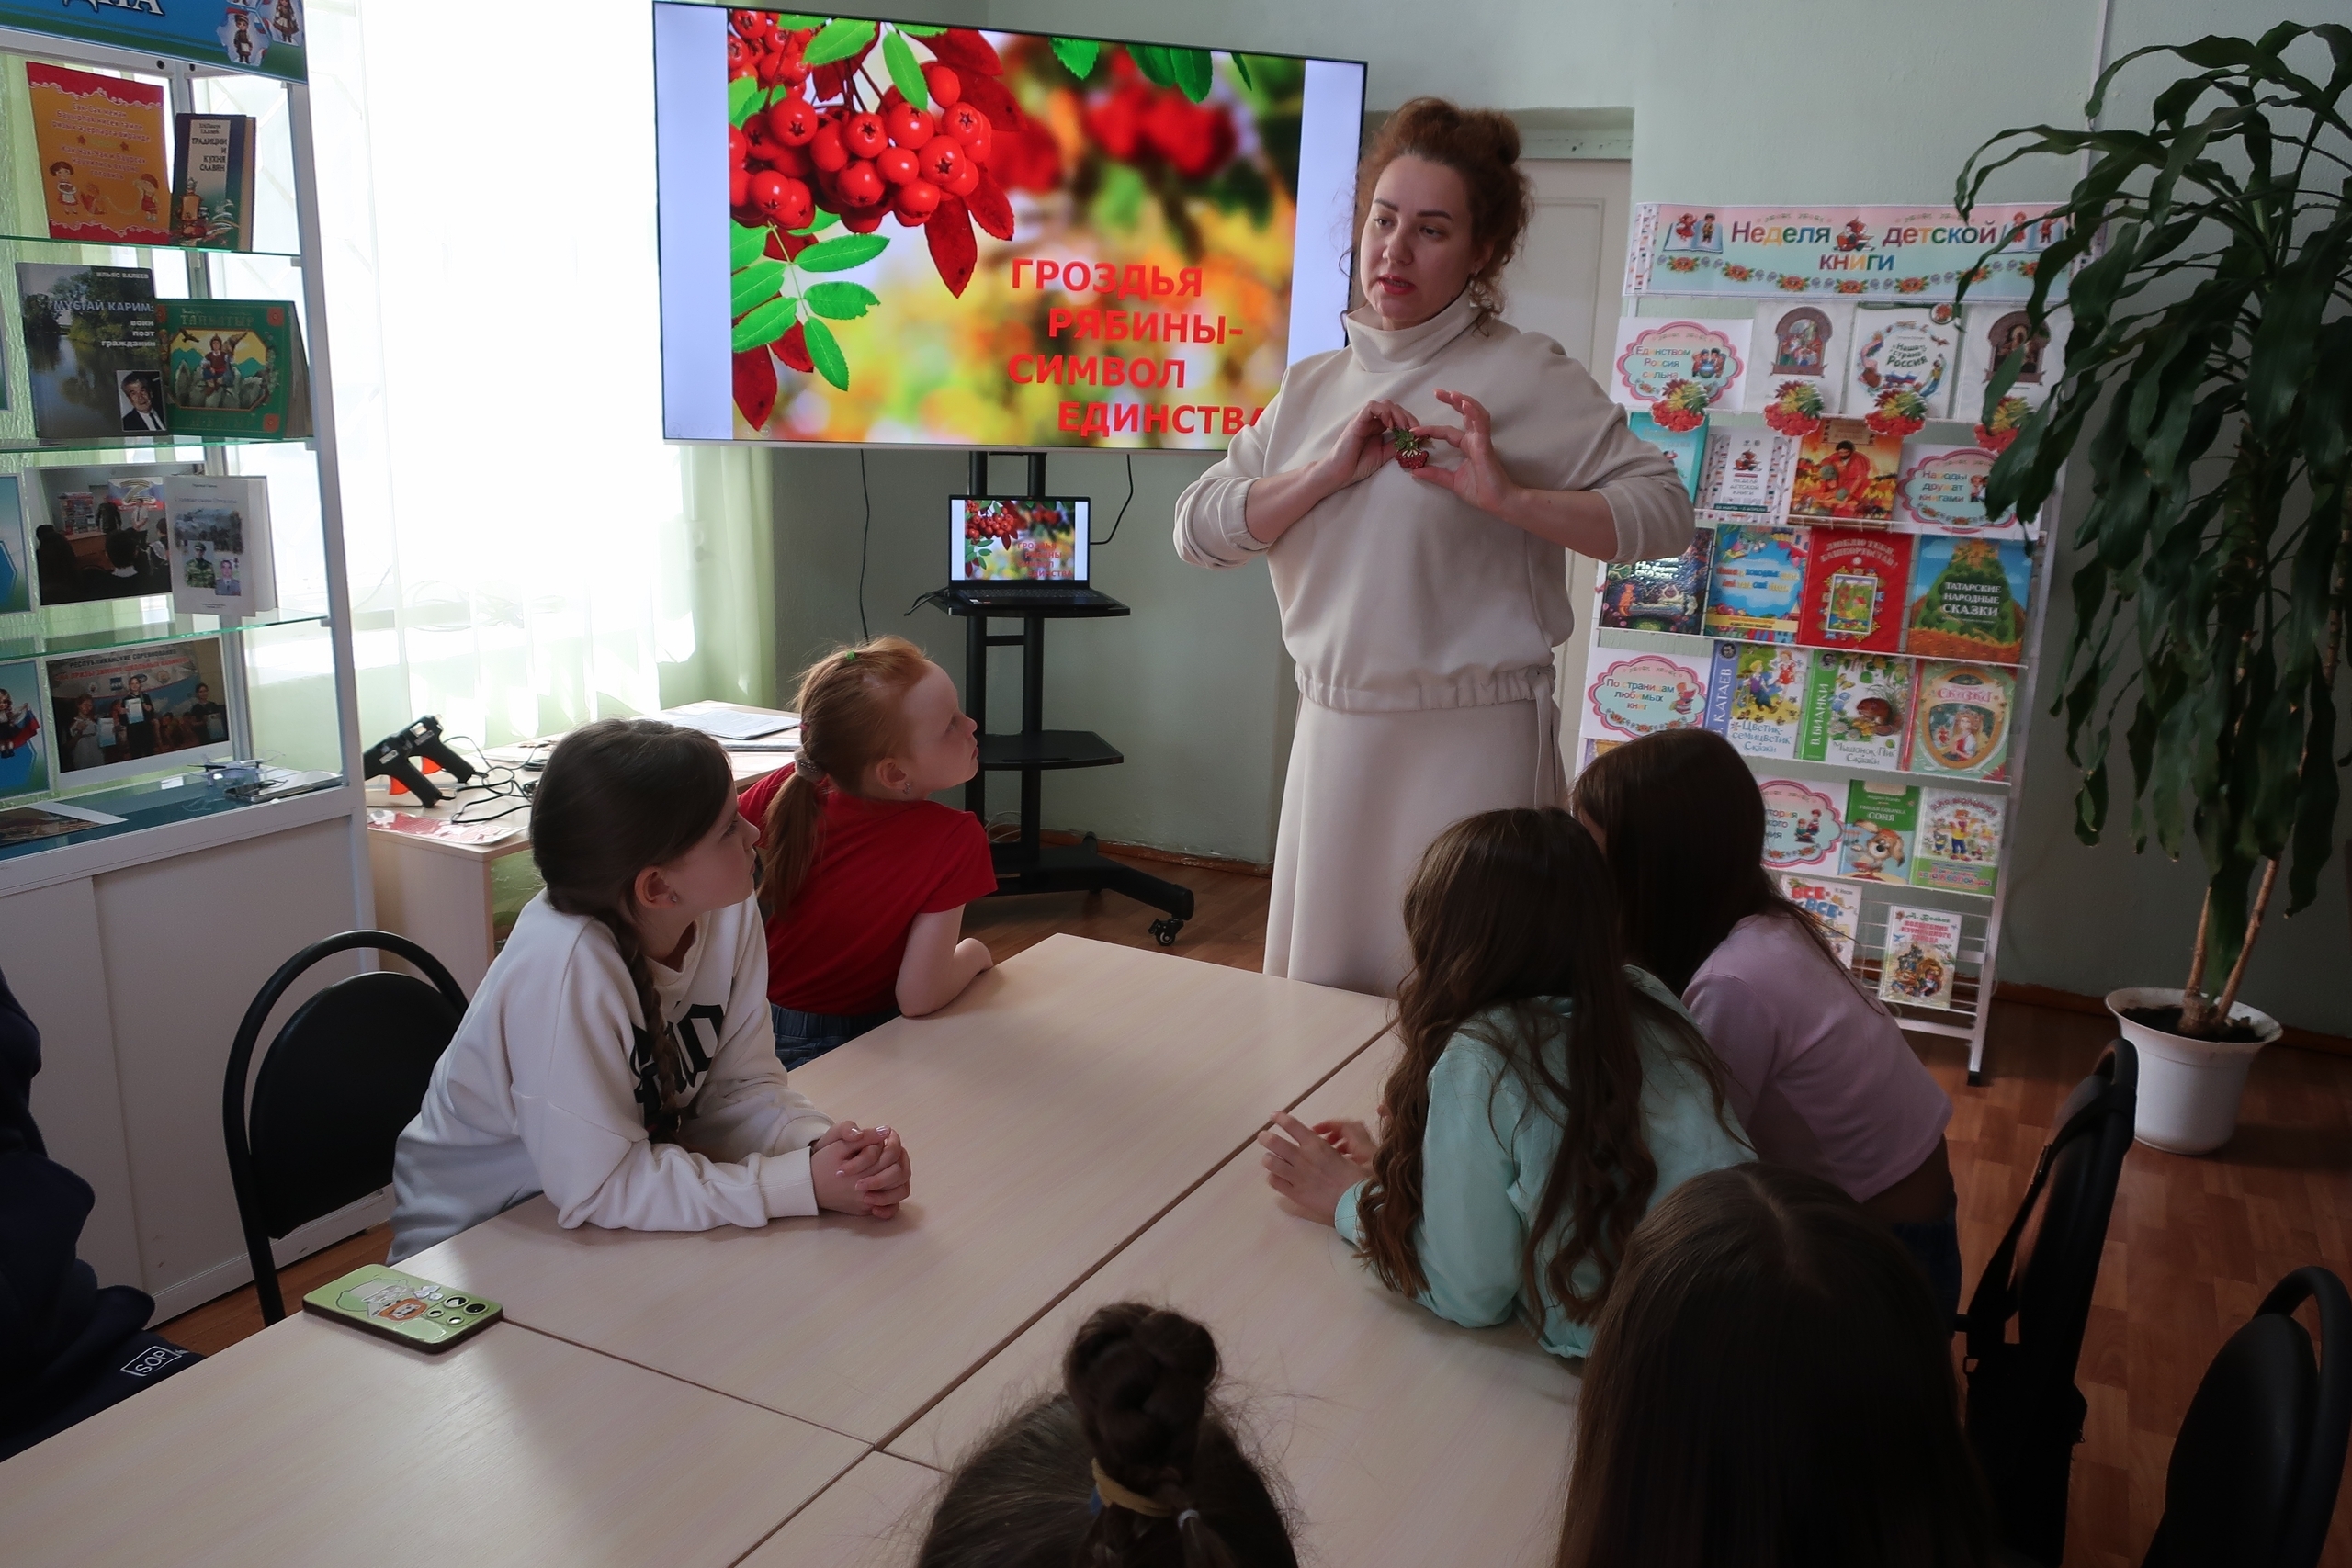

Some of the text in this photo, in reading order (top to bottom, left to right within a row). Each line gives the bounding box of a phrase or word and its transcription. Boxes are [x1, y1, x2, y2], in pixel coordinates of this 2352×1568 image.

[192, 137, 228, 145] ТРАДИЦИИ
[199, 164, 225, 172] СЛАВЯН
[1731, 219, 1996, 247] Неделя детской
[1819, 254, 1895, 271] книги
[1012, 257, 1203, 301] ГРОЗДЬЯ
[107, 302, 154, 311] КАРИМ:
[1048, 308, 1244, 344] РЯБИНЫ-
[101, 340, 156, 348] гражданин
[1635, 345, 1691, 357] Единством
[1644, 358, 1680, 367] Россия
[1007, 354, 1186, 389] СИМВОЛ
[1922, 470, 1968, 481] Народы
[1922, 481, 1964, 492] дружат
[1919, 493, 1964, 502] книгами
[1945, 581, 2002, 593] ТАТАРСКИЕ
[1943, 592, 2000, 604] НАРОДНЫЕ
[1942, 604, 1998, 616] СКАЗКИ
[1606, 678, 1675, 694] По страницам
[1614, 690, 1664, 702] любимых
[1713, 668, 1732, 723] КАТАЕВ
[1627, 702, 1649, 711] книг
[1744, 740, 1777, 753] Сказки
[1833, 741, 1896, 758] Мышонок Пик
[1846, 753, 1881, 765] Сказки
[1868, 811, 1895, 822] СОНЯ
[1905, 920, 1949, 932] ВОЛШЕБНИК
[1901, 926, 1951, 940] ИЗУМРУДНОГО
